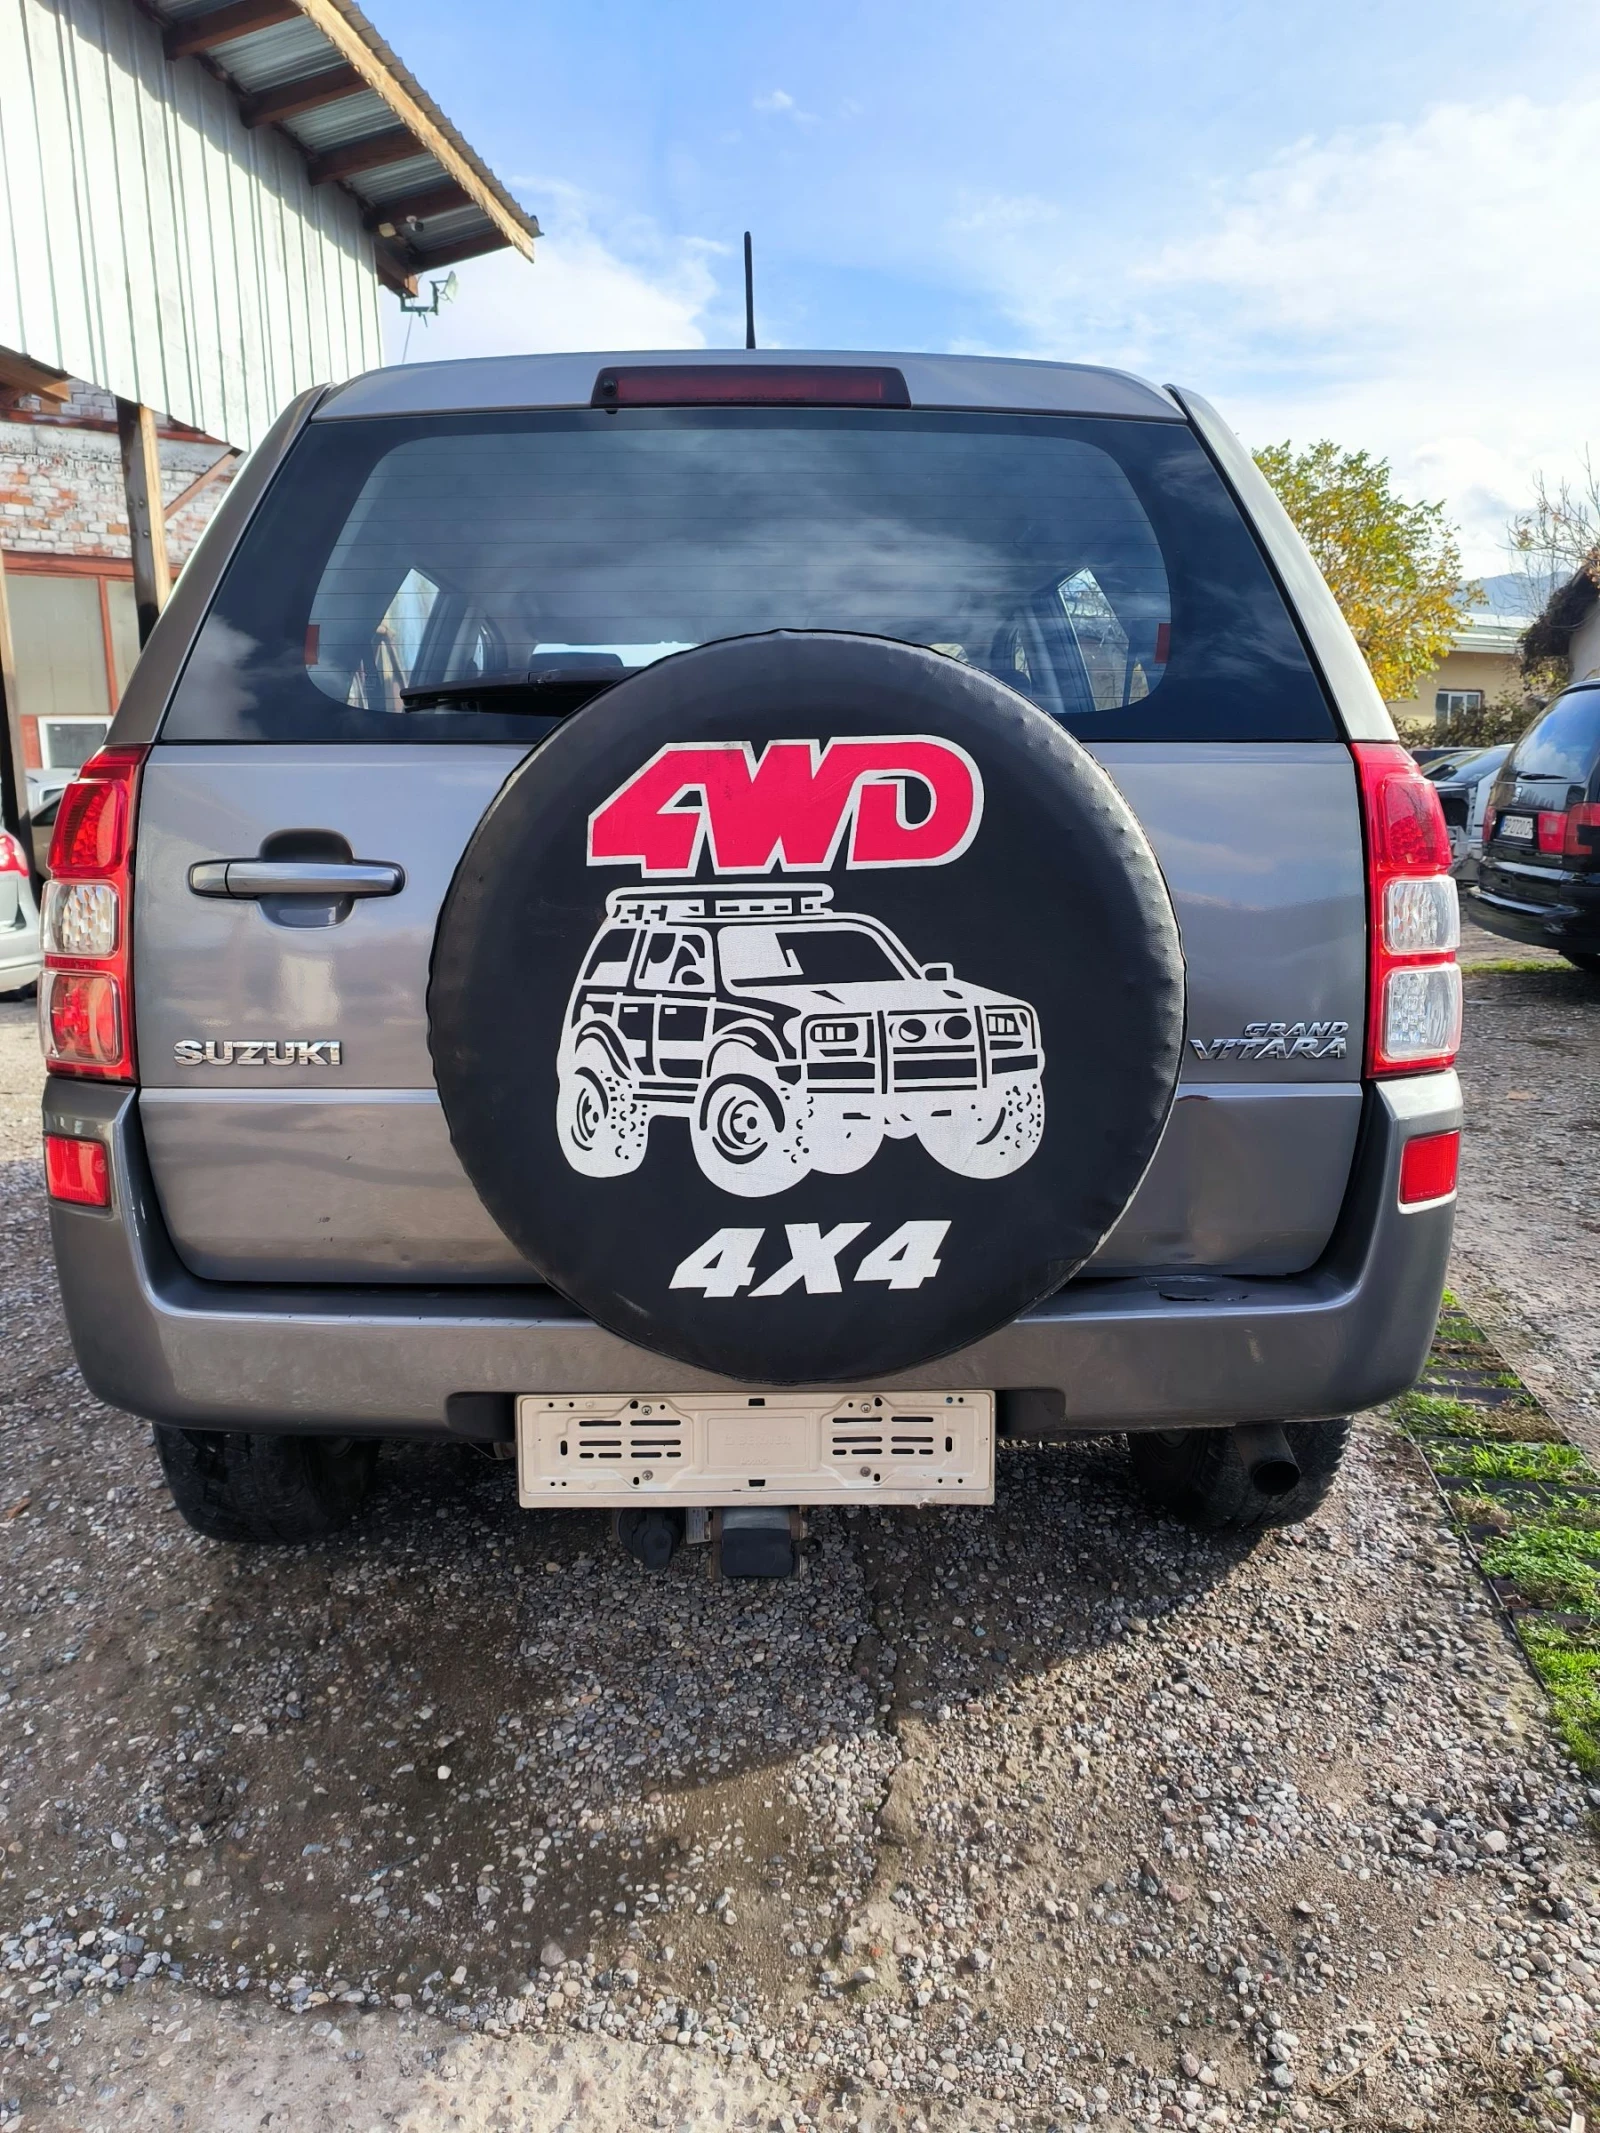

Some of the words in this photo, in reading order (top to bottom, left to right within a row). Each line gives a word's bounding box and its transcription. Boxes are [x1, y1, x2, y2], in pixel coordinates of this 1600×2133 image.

[586, 734, 984, 878] 4WD
[1244, 1021, 1349, 1038] GRAND
[173, 1040, 342, 1066] SUZUKI
[1189, 1037, 1347, 1061] VITARA
[668, 1220, 952, 1299] 4X4
